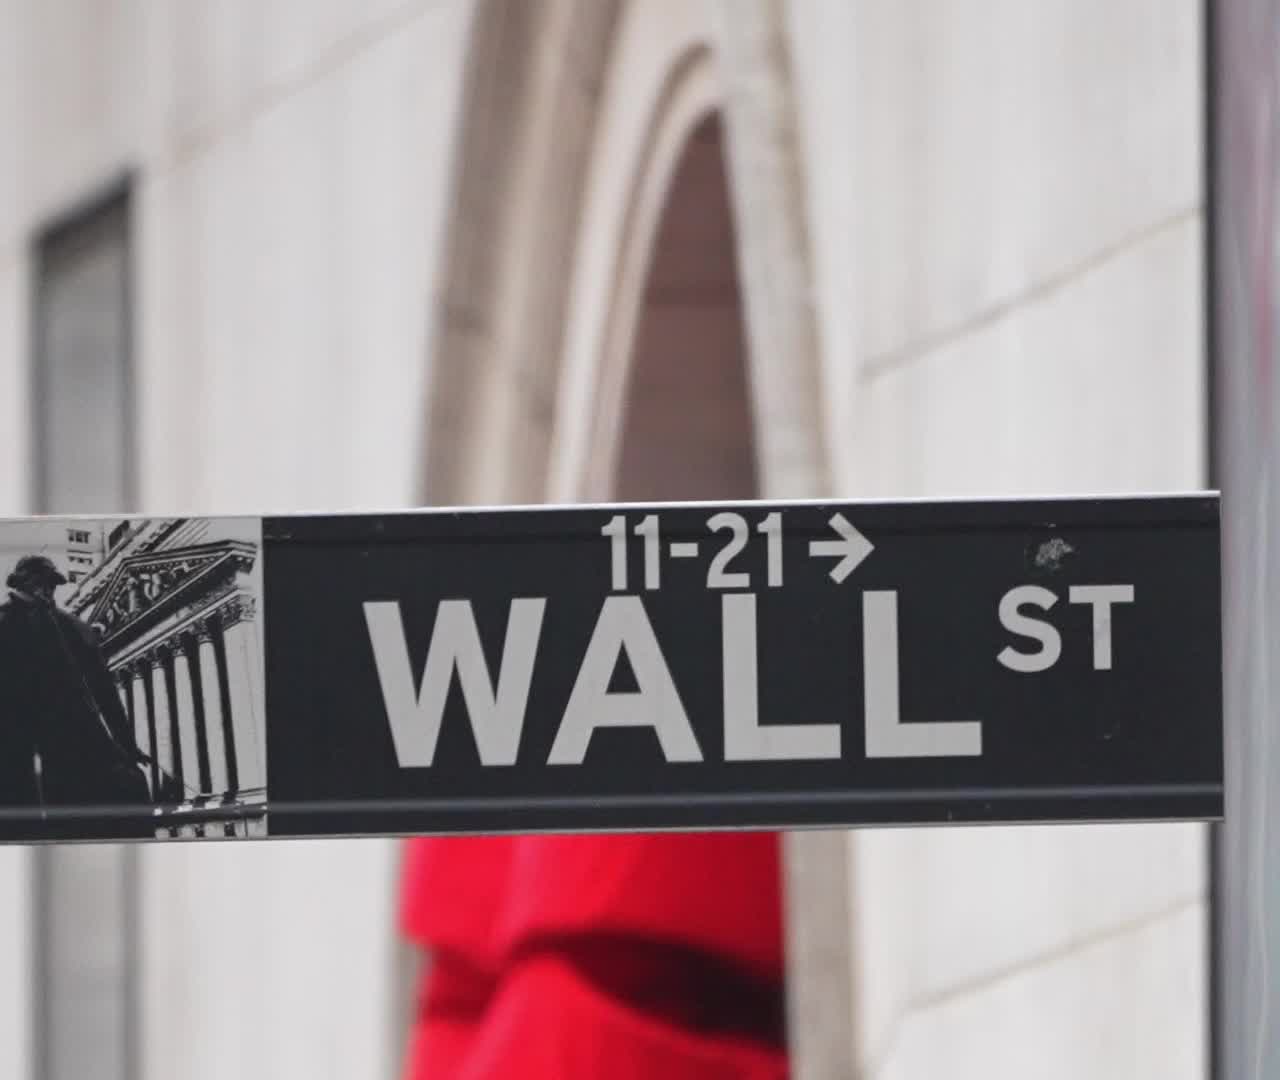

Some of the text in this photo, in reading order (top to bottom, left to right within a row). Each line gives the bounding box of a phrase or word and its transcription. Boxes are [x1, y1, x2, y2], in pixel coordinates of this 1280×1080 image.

[602, 513, 783, 590] 11-21
[364, 585, 1134, 767] WALL ST
